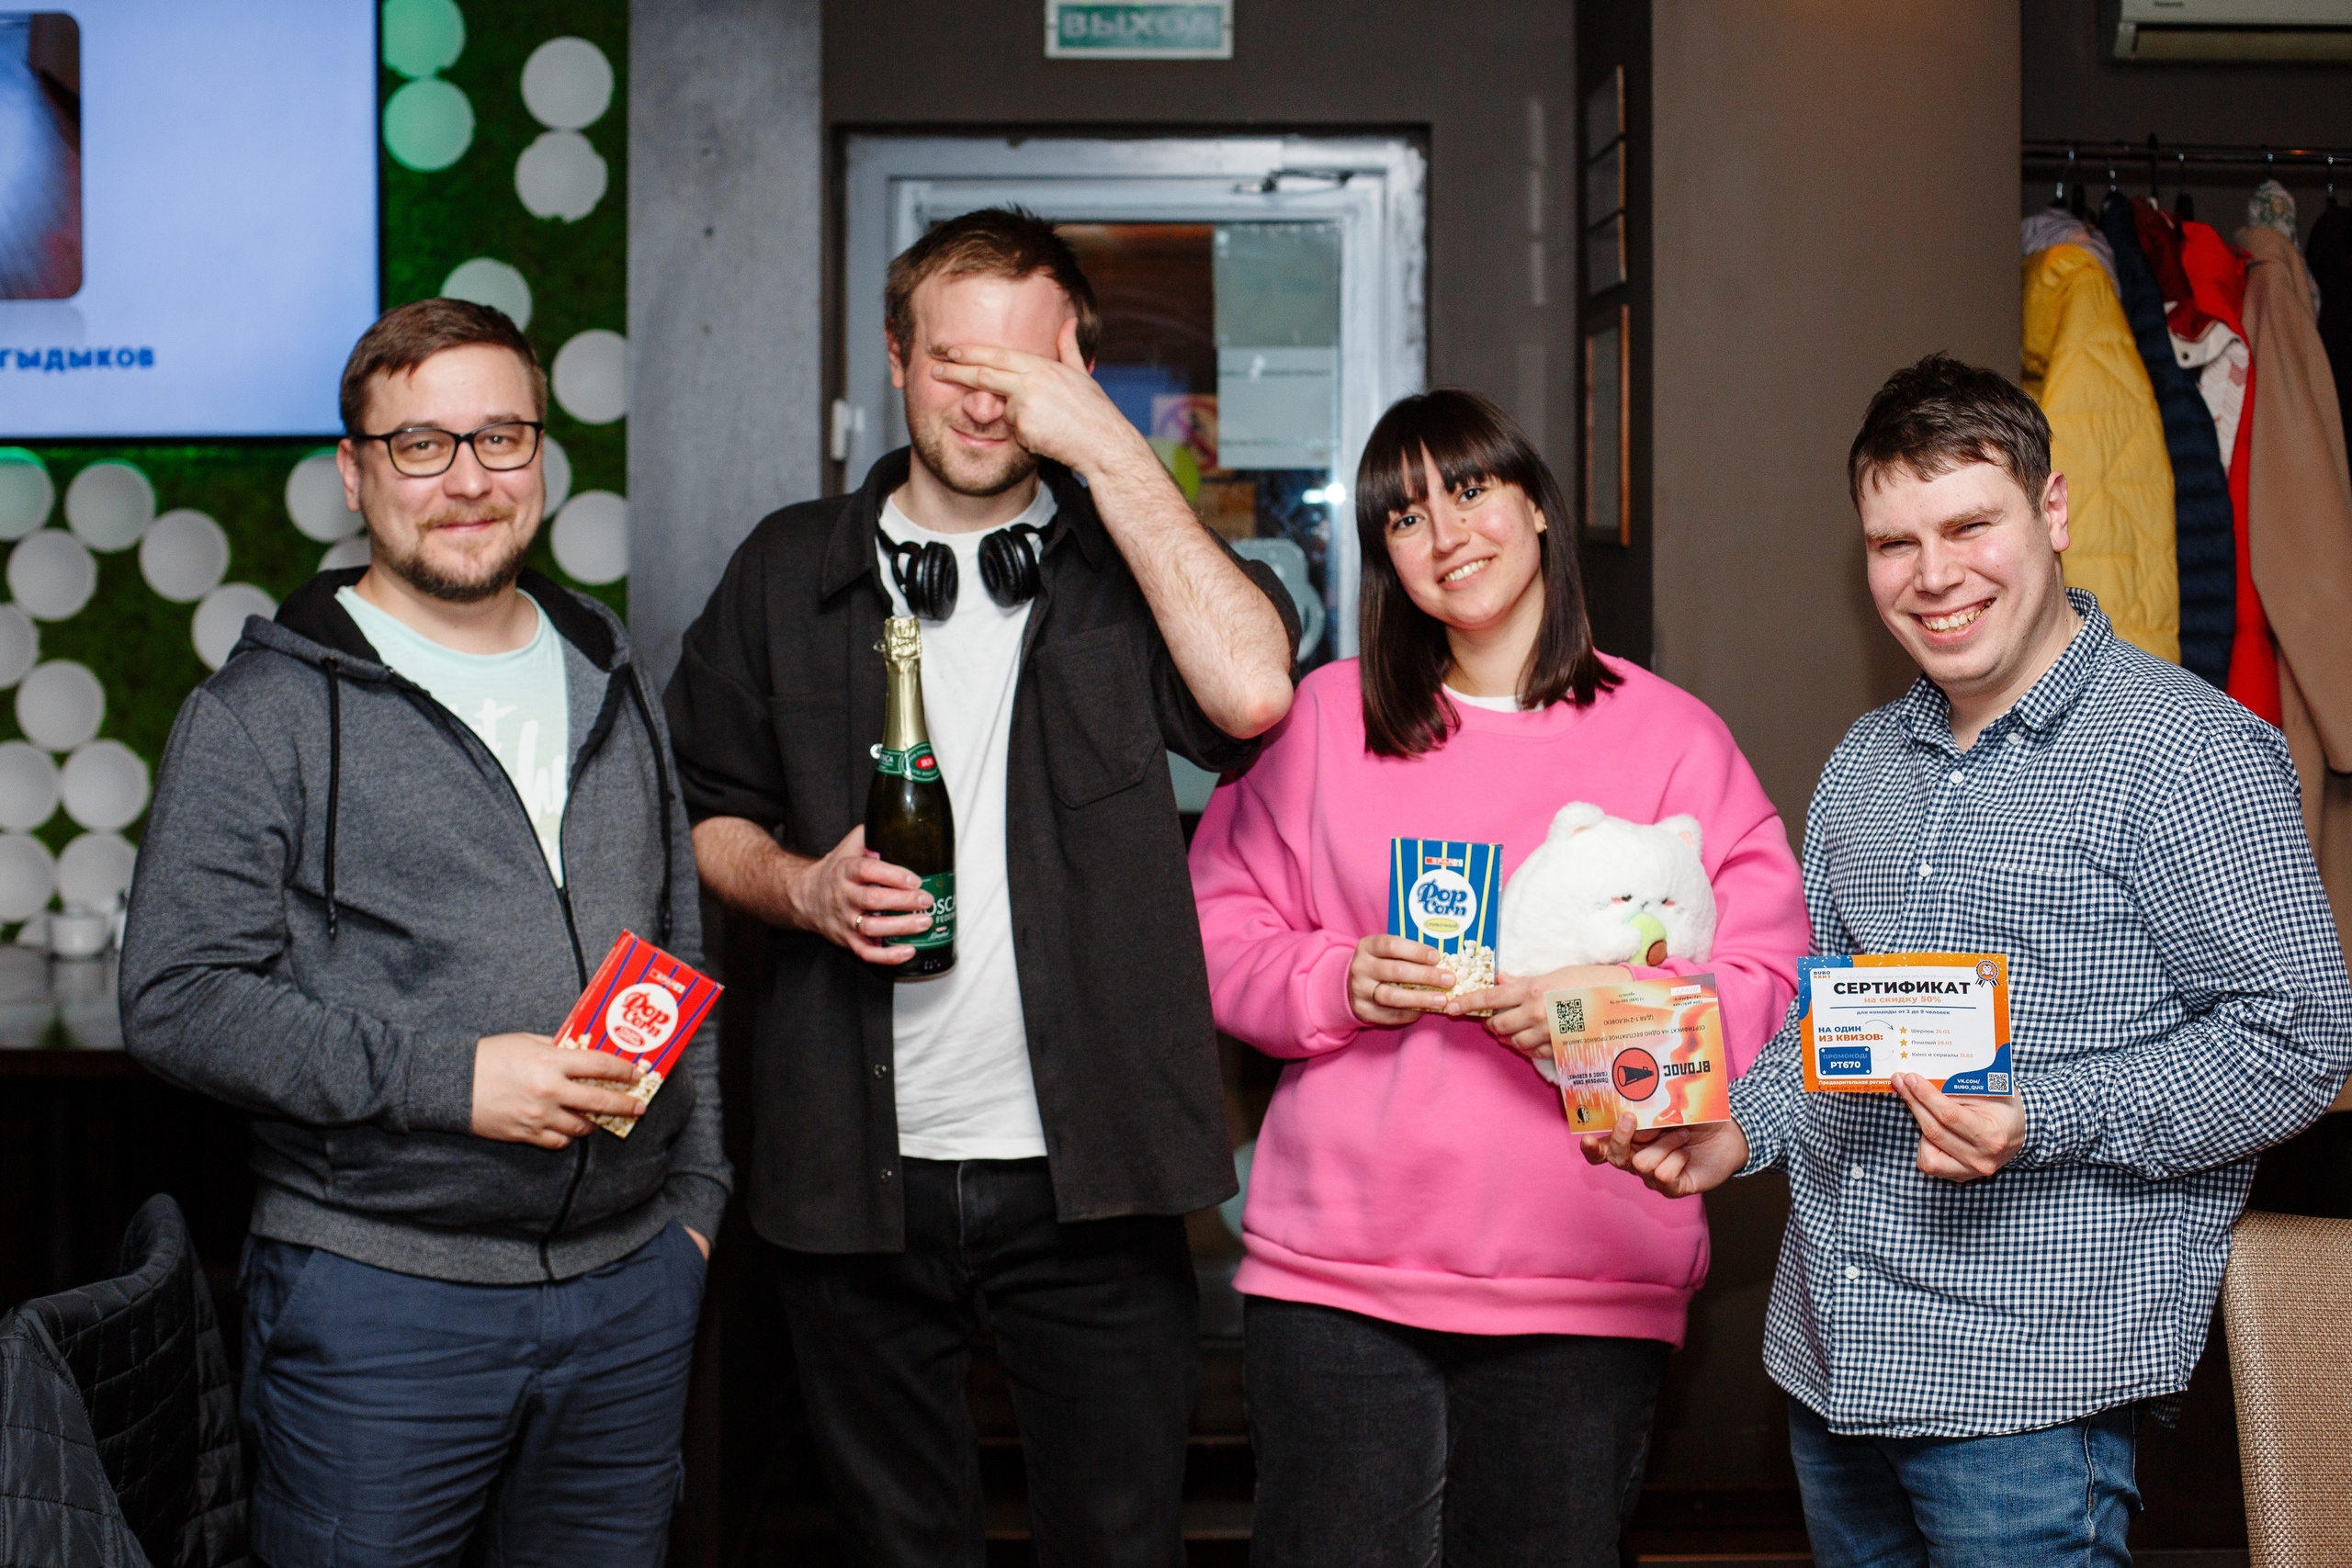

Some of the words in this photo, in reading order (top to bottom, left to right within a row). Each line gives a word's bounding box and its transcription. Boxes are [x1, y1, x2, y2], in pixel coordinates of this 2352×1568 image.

[1062, 12, 1217, 39] ВЫХОД
[1417, 879, 1467, 908] Pop
[912, 894, 956, 916] OSC
[1423, 899, 1467, 917] Corn
[1834, 981, 1971, 995] СЕРТИФИКАТ
[621, 992, 671, 1025] Pop
[622, 1007, 662, 1038] Corn
[1602, 1017, 1629, 1025] ЧЕЛОВЕК)
[1639, 1013, 1654, 1021] (ДЛЯ
[1669, 1024, 1705, 1033] СЕРТИФИКАТ
[1834, 1025, 1861, 1033] ОДИН
[1583, 1035, 1607, 1043] ПРОБНОЕ
[1608, 1032, 1643, 1041] БЕСПЛАТНОЕ
[1837, 1033, 1883, 1042] КВИЗОВ:
[1663, 1061, 1711, 1077] ВГОЛОС
